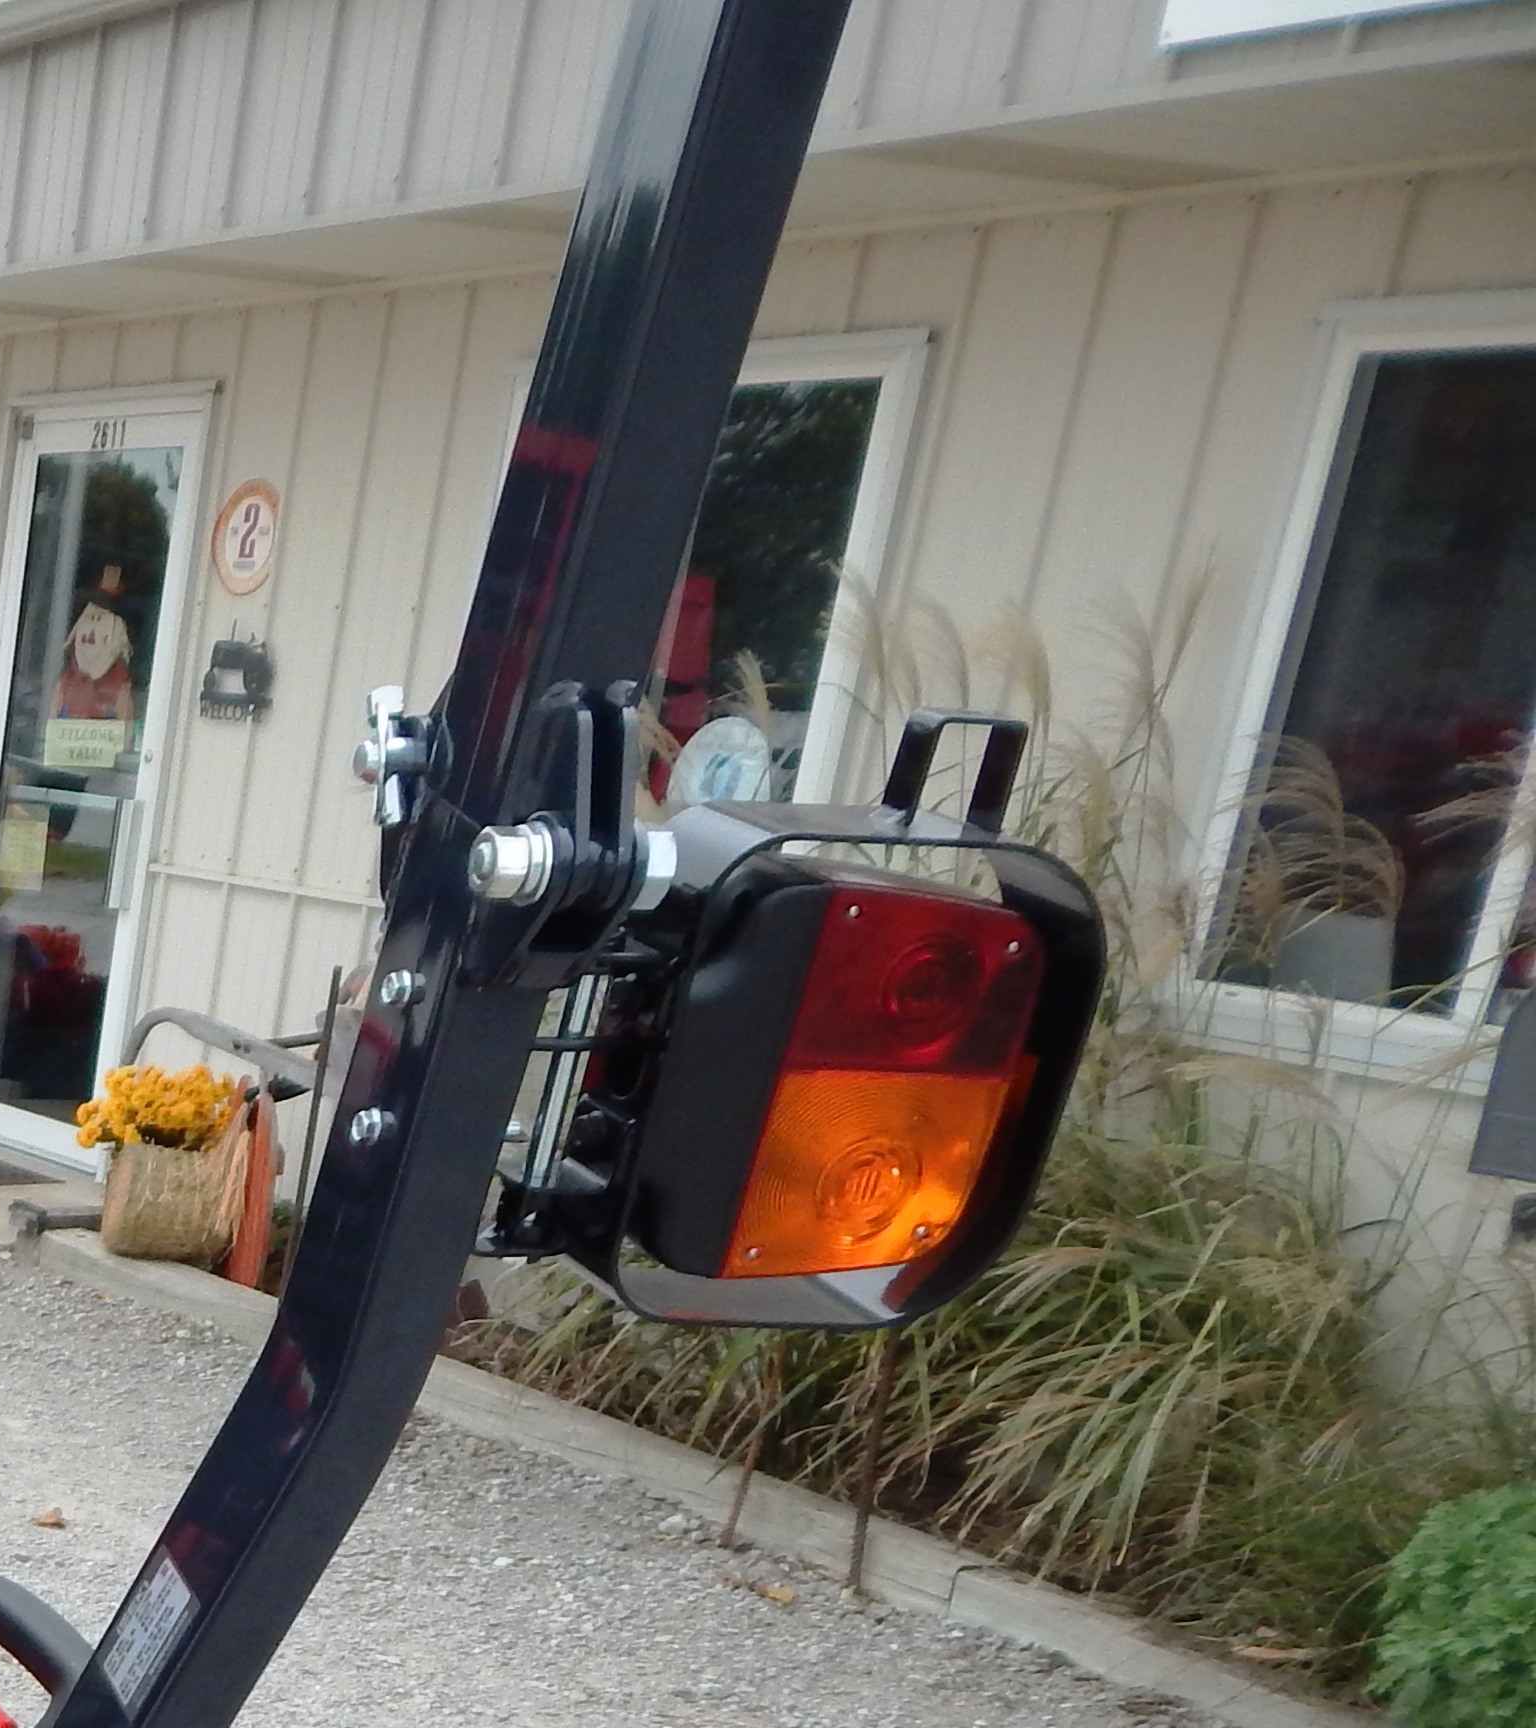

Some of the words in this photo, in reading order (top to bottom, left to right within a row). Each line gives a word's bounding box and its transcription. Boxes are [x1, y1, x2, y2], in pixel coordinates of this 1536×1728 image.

[91, 419, 126, 449] 2611
[238, 503, 261, 558] 2
[200, 700, 263, 723] WELCOME
